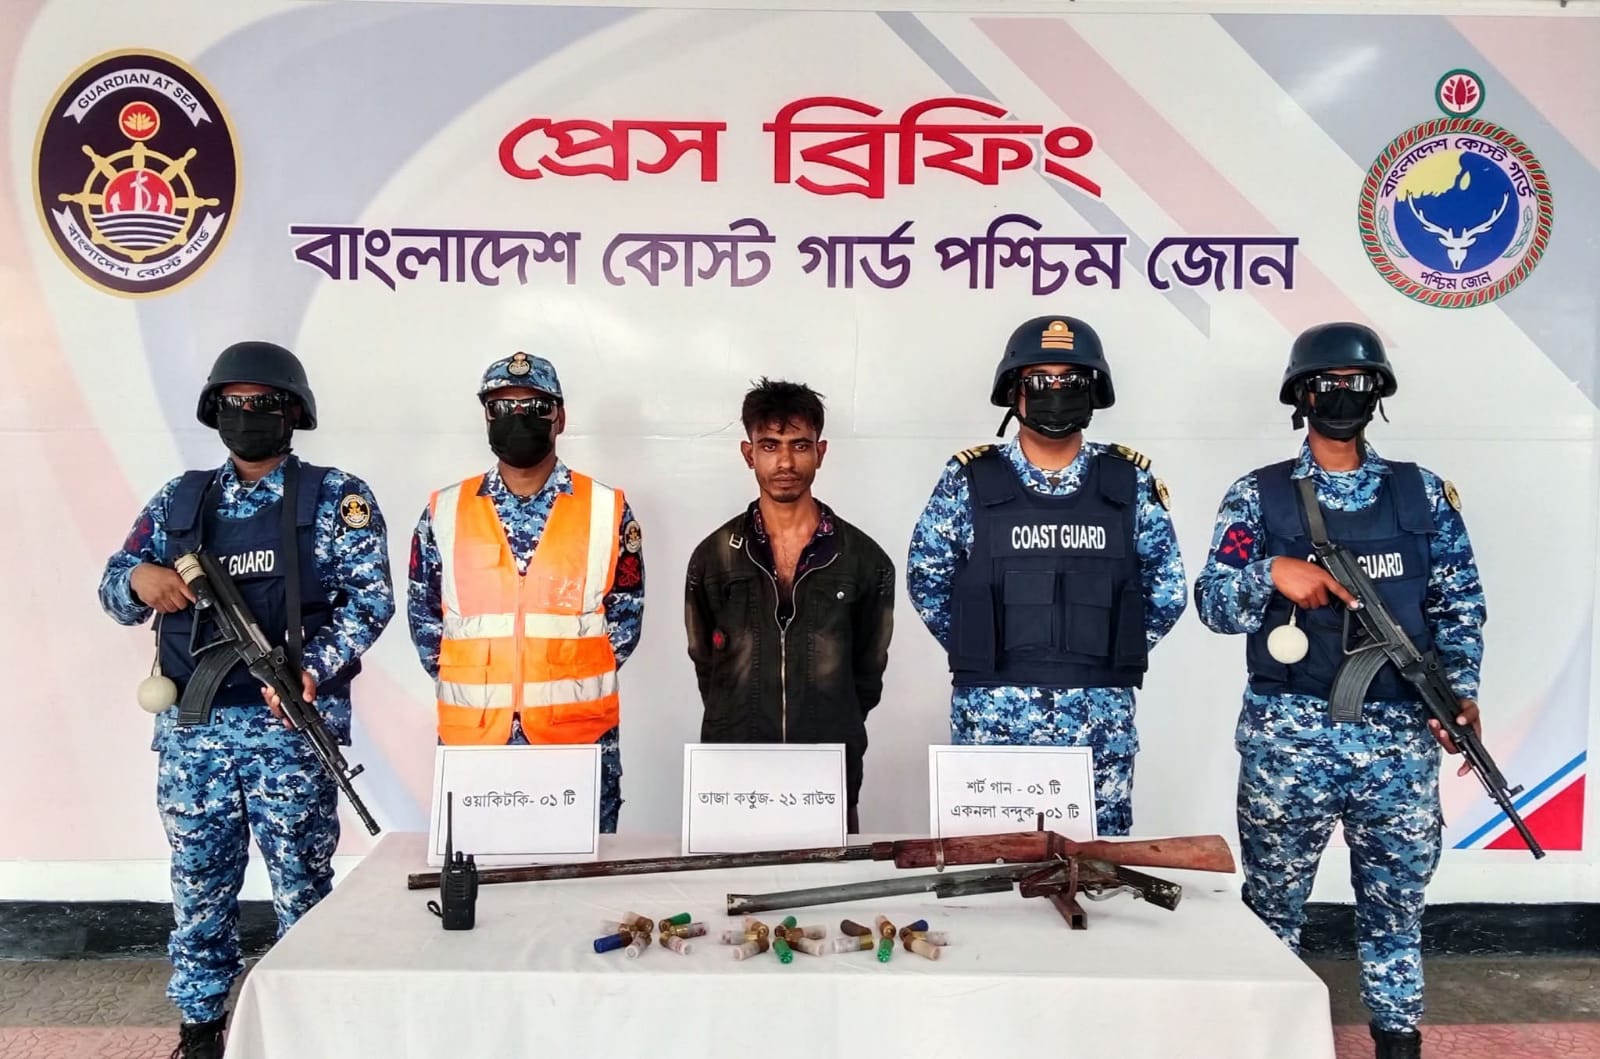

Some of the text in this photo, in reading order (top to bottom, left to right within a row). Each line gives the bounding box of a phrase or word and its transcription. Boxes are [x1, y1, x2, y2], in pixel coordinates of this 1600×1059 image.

[78, 73, 198, 114] GUARDIAN AT SEA
[499, 96, 1102, 199] প্রেস ব্রিফিং
[1381, 137, 1535, 199] বাংলাদেশ কোস্ট গার্ড
[68, 223, 131, 277] বাংলাদেশ
[137, 255, 182, 278] কোস্ট
[290, 213, 1299, 296] বাংলাদেশ কোস্ট গার্ড পশ্চিম জোন
[1420, 271, 1492, 290] পশ্চিম জোন
[1011, 524, 1106, 550] COAST GUARD
[229, 549, 275, 577] GUARD
[540, 794, 558, 807] ০১
[563, 789, 576, 806] টি
[698, 791, 730, 806] তাজা
[779, 793, 797, 807] ২১
[802, 789, 836, 806] রাউন্ড
[966, 778, 987, 795] শর্ট
[990, 781, 1012, 795] গান
[1027, 783, 1045, 796] ০১
[1049, 779, 1062, 795] টি
[951, 805, 996, 819] একনলা
[1045, 807, 1063, 819] ০১
[1067, 804, 1080, 819] টি
